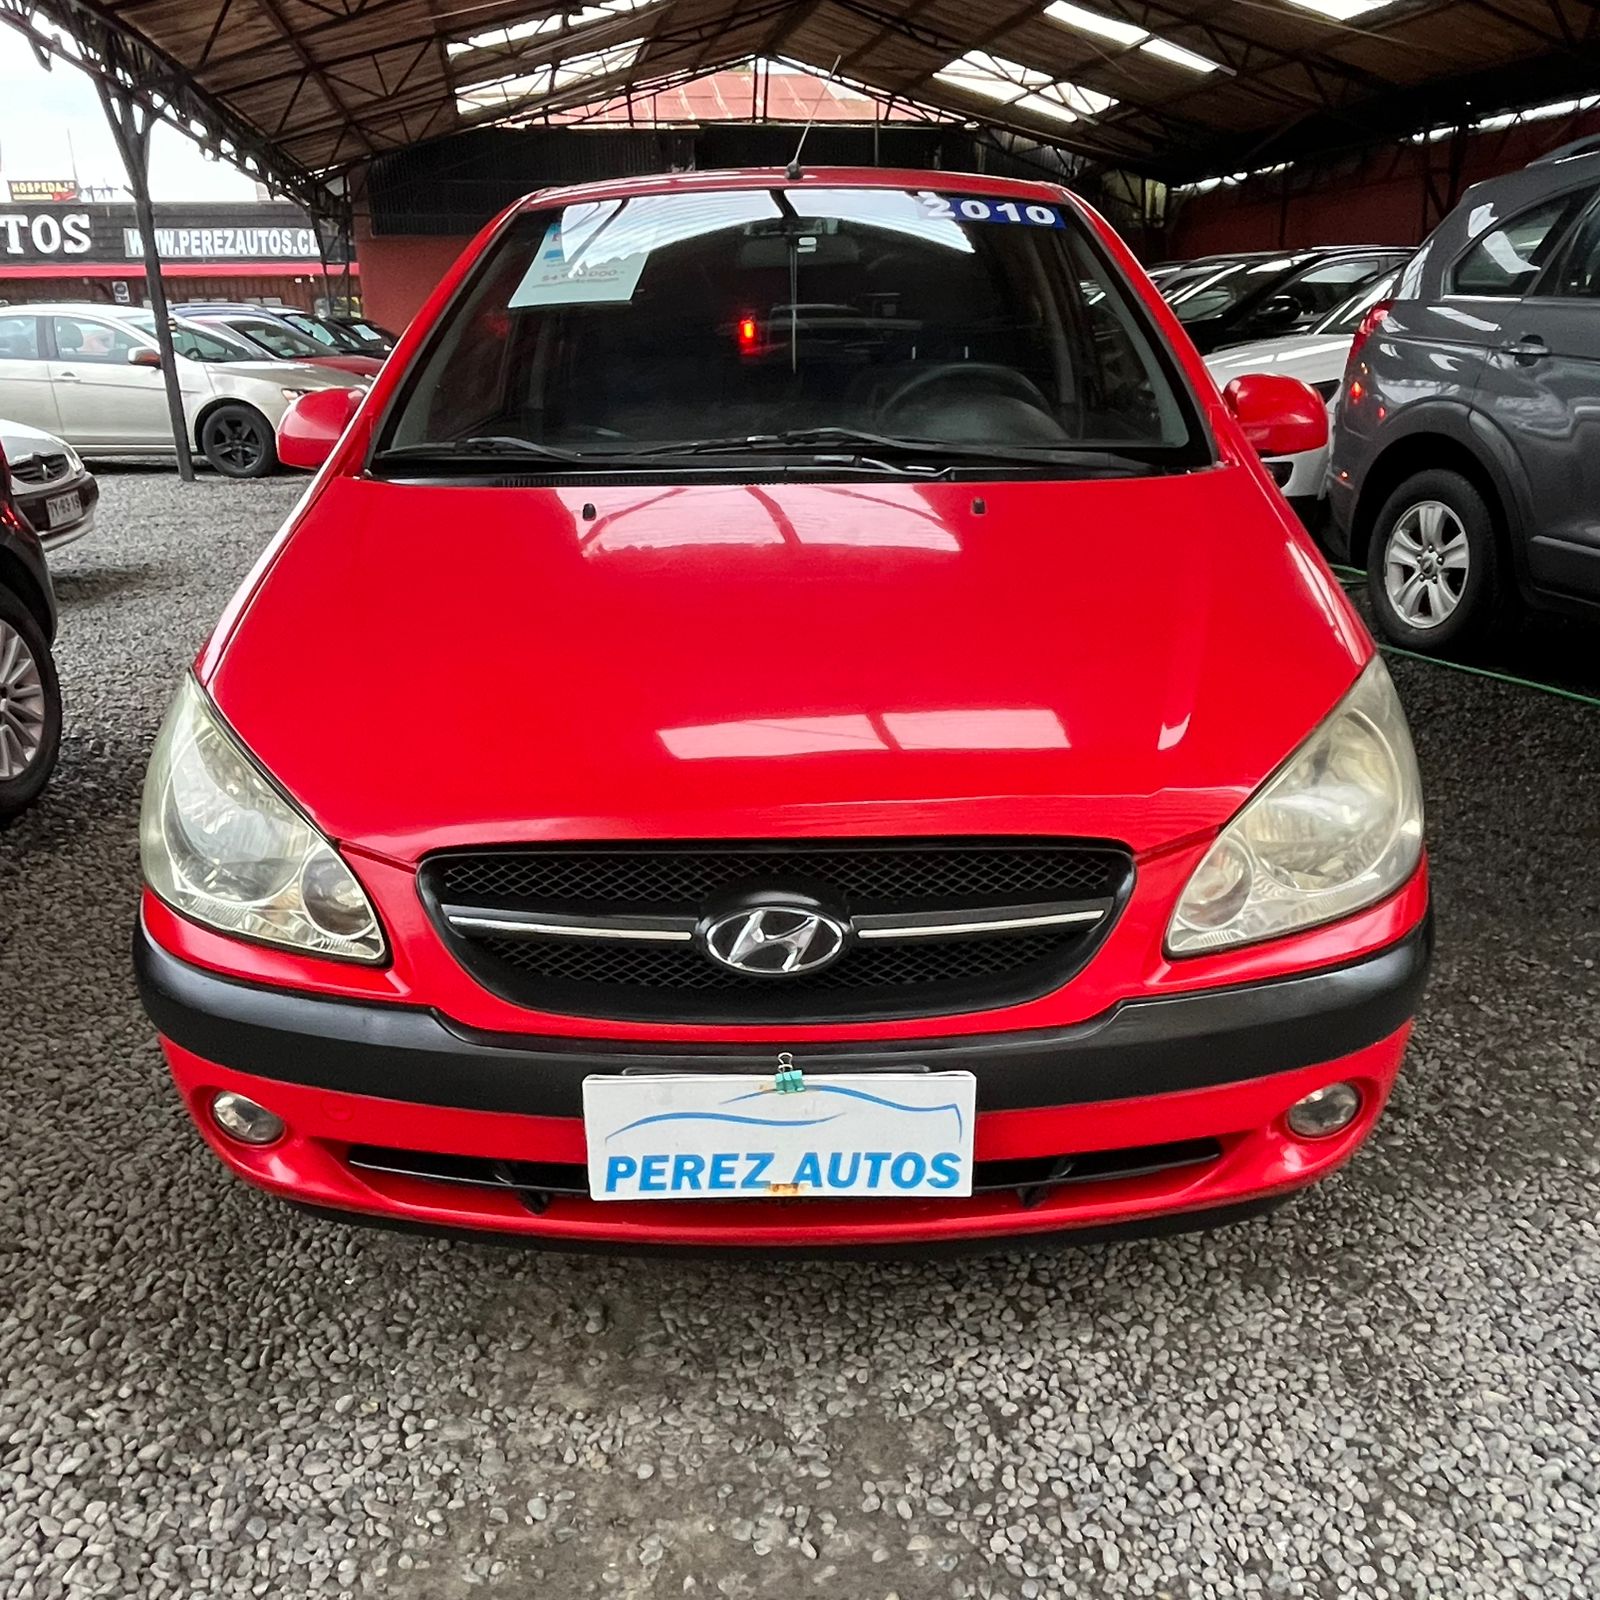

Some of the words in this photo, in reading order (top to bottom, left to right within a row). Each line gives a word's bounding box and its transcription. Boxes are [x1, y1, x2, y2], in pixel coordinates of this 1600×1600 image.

[923, 199, 1056, 225] 2010
[127, 229, 320, 256] WW.PEREZAUTOS.CL
[605, 1152, 775, 1192] PEREZ
[797, 1151, 962, 1190] AUTOS
